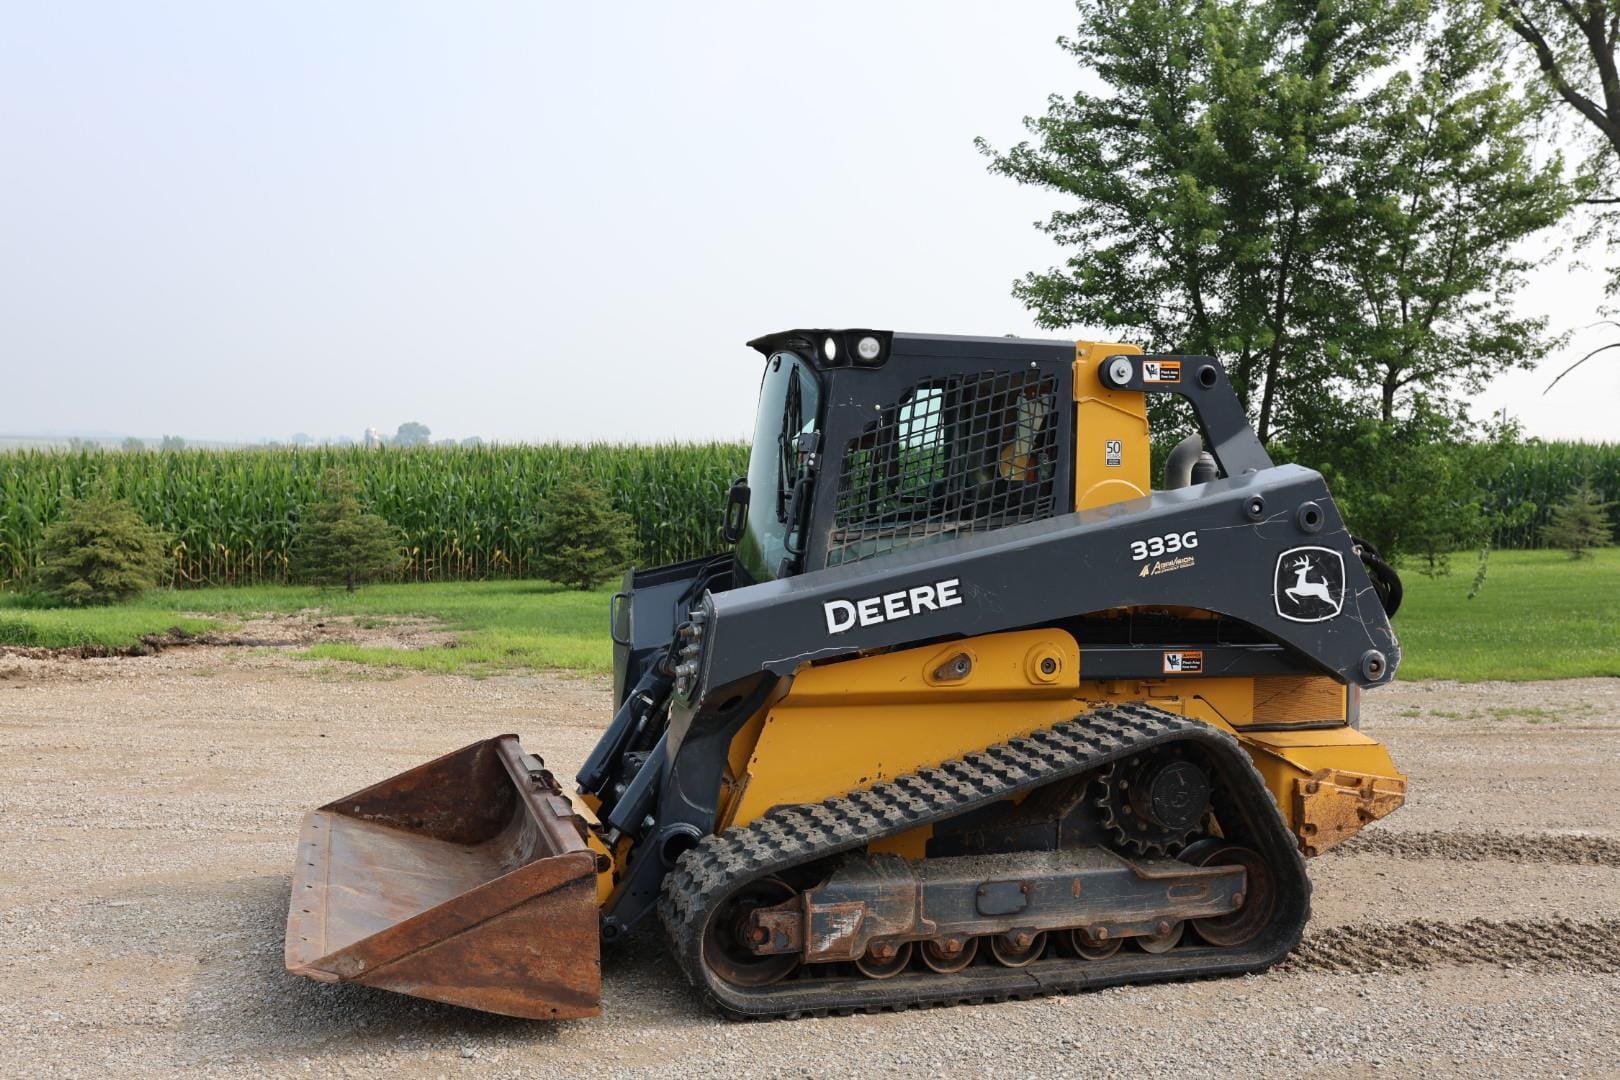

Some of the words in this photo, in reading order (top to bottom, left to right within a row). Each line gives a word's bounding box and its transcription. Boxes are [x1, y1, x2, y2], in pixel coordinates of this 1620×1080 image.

[1106, 441, 1121, 454] 50
[1130, 531, 1198, 561] 333G
[824, 578, 962, 634] DEERE
